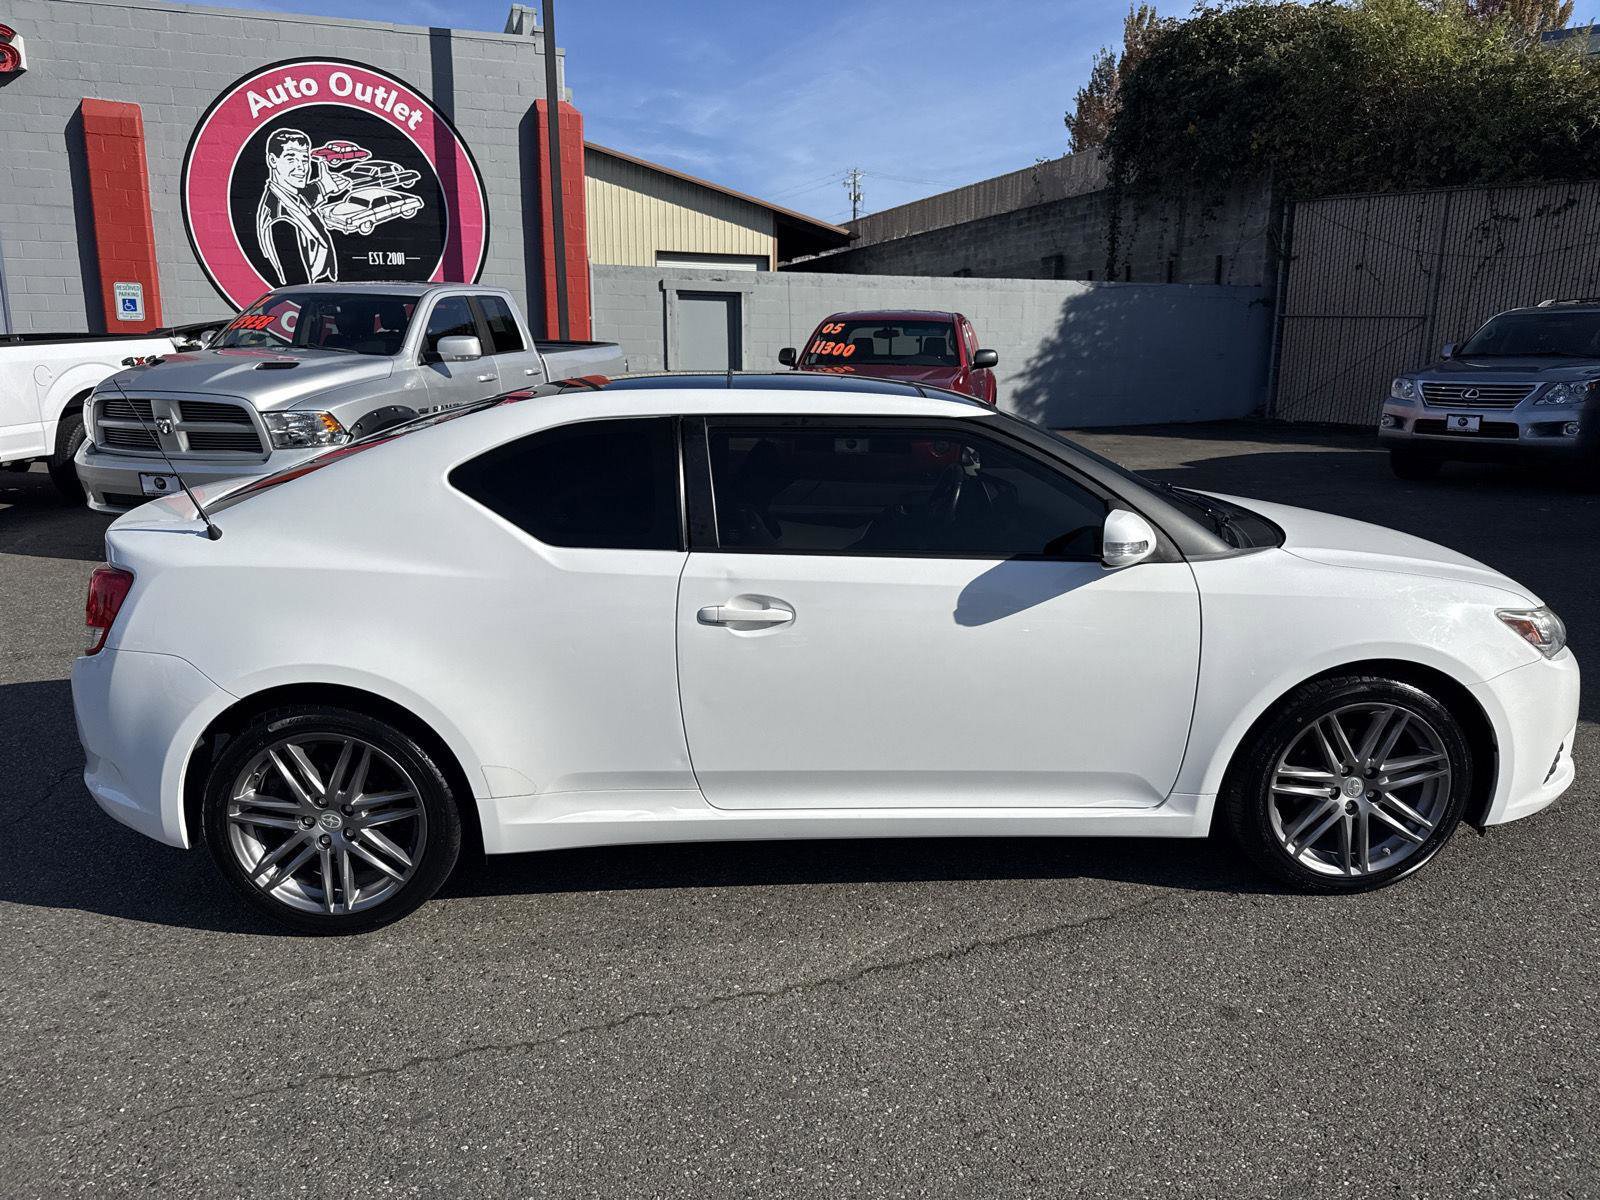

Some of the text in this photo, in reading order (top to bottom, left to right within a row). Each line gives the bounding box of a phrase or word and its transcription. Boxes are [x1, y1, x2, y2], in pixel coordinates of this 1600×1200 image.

[246, 71, 423, 131] Auto Outlet
[368, 251, 405, 265] EST. 2001
[822, 322, 846, 335] 05
[810, 340, 856, 358] 11300
